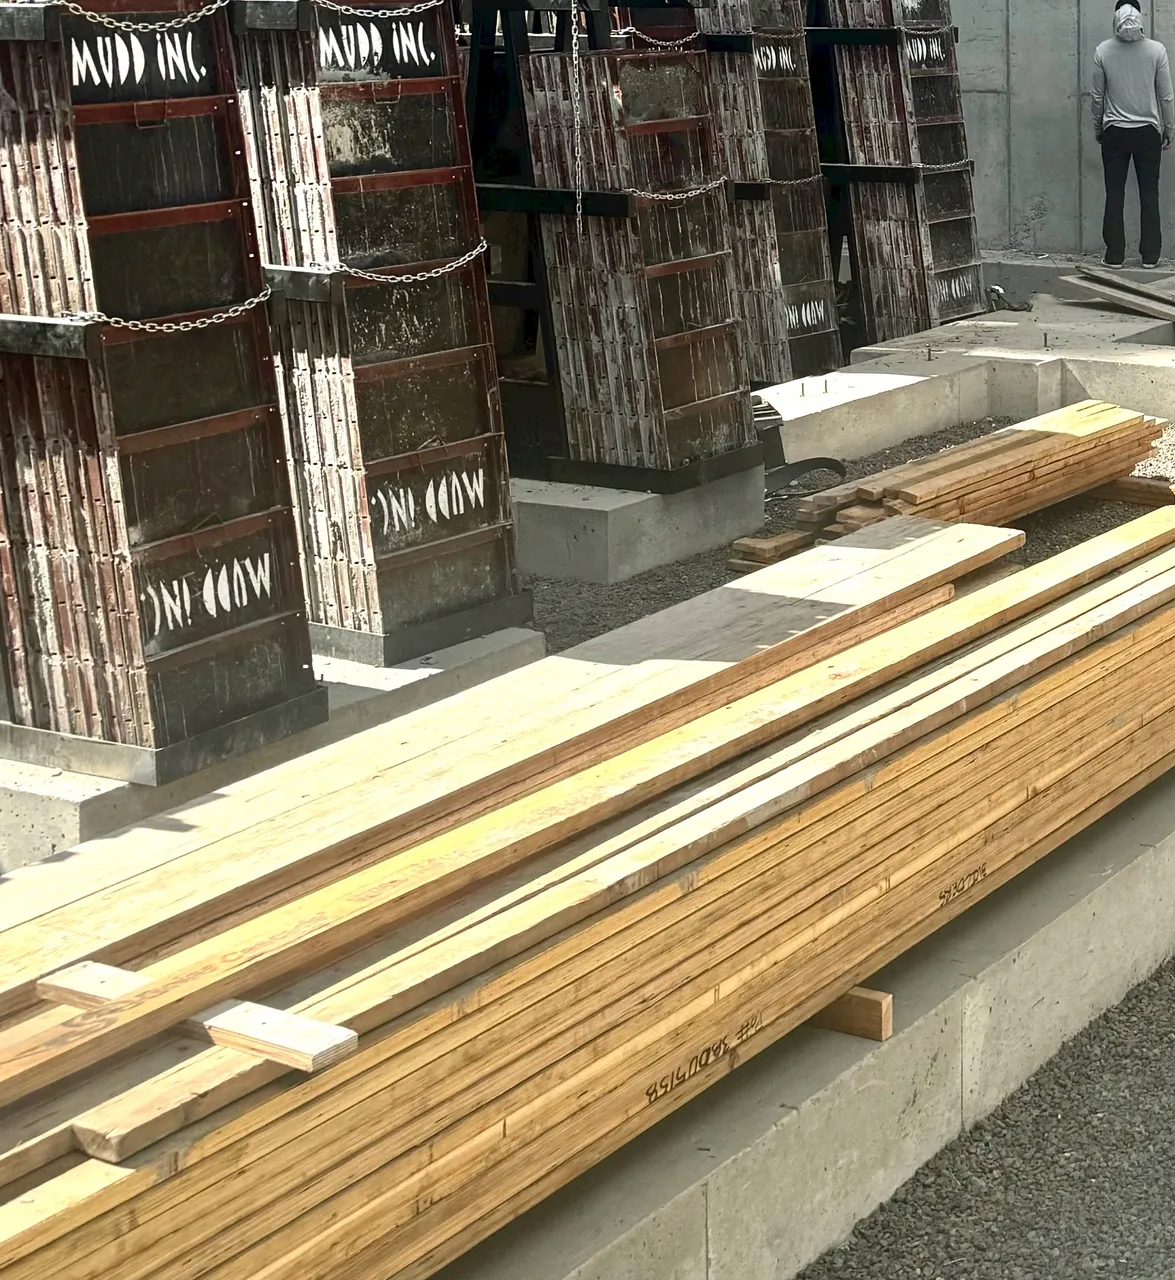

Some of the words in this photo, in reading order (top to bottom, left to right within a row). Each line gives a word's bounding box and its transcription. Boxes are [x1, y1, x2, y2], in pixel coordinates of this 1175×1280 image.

[71, 33, 145, 88] MUDD
[319, 22, 383, 72] MUDD
[907, 38, 927, 62] MUDD
[801, 299, 824, 327] MUDD
[425, 468, 485, 523] MUDD
[202, 552, 271, 618] MUDD
